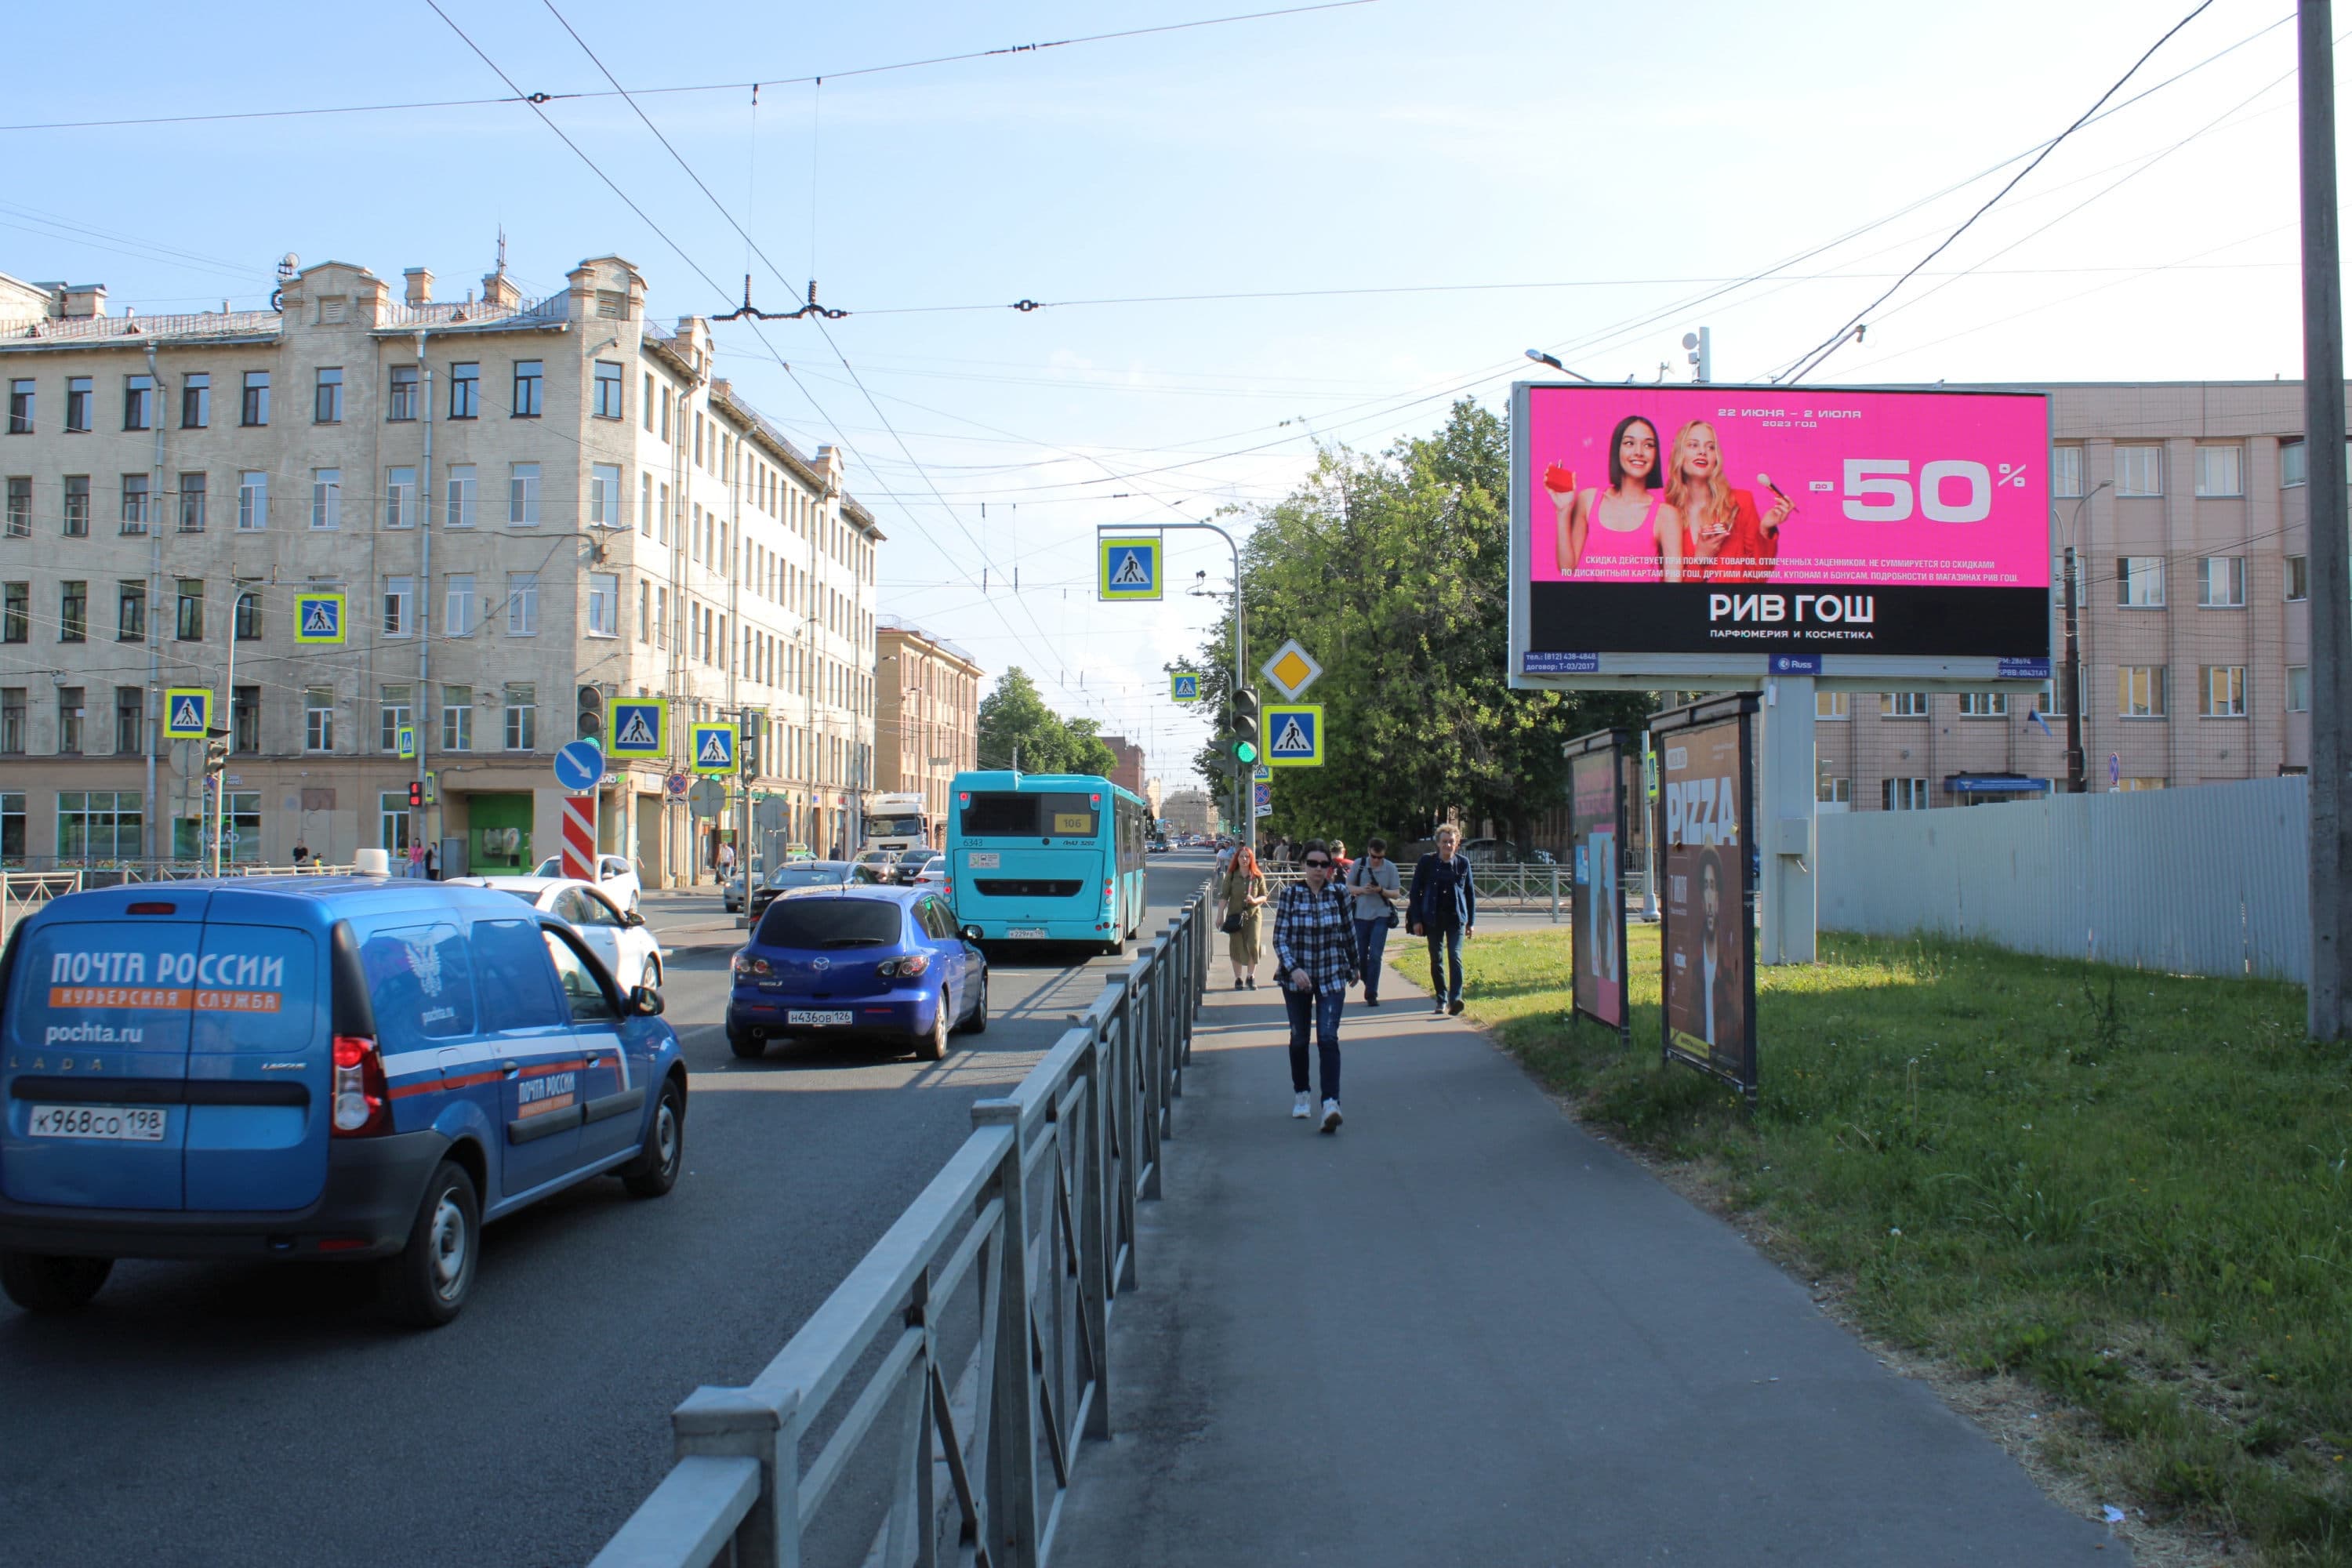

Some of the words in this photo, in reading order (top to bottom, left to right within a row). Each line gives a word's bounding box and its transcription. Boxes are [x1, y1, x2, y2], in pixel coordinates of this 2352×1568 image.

[1718, 408, 1736, 417] 22
[1741, 408, 1784, 417] ИЮНЯ
[1804, 409, 1813, 418] 2
[1818, 410, 1862, 419] ИЮЛЯ
[1585, 556, 1617, 564] СКИДКА
[1619, 555, 1664, 565] ДЕЙСТВУЕТ
[1683, 557, 1719, 565] ПОКУПКЕ
[1759, 557, 1812, 566] ОТМЕЧЕННЫХ
[1869, 559, 1879, 568] НЕ
[1881, 559, 1939, 568] СУММИРУЕТСЯ
[1940, 560, 1951, 568] СО
[1952, 561, 1994, 569] СКИДКАМИ
[1561, 568, 1572, 577] ПО
[1573, 568, 1629, 578] ДИСКОНТНЫМ
[1632, 569, 1664, 578] КАРТАМ
[1703, 570, 1740, 579] ДРУГИМИ
[1784, 571, 1821, 579] КУПОНАМ
[1871, 572, 1927, 581] ПОДРОБНОСТИ
[1936, 573, 1981, 582] МАГАЗИНАХ
[1710, 593, 1786, 622] РИВ
[1795, 594, 1874, 622] ГОШ
[1710, 630, 1788, 638] ПАРФЮМЕРИЯ
[1805, 630, 1874, 639] КОСМЕТИКА
[1791, 660, 1813, 669] Russ
[1667, 777, 1738, 845] PIZZA
[1064, 818, 1082, 829] 106
[964, 838, 983, 848] 6343
[51, 953, 145, 983] ПОЧТА
[157, 953, 285, 987] РОССИИ
[61, 989, 179, 1007] КУРЬЕРСКАЯ
[197, 992, 276, 1010] СЛУЖБА
[834, 1012, 850, 1021] 126
[45, 1022, 143, 1045] pochta.ru
[9, 1054, 103, 1071] LADA
[518, 1078, 545, 1104] ПОЧТА
[546, 1072, 575, 1098] РОССИИ
[36, 1109, 120, 1134] К968СО
[127, 1110, 159, 1130] 198
